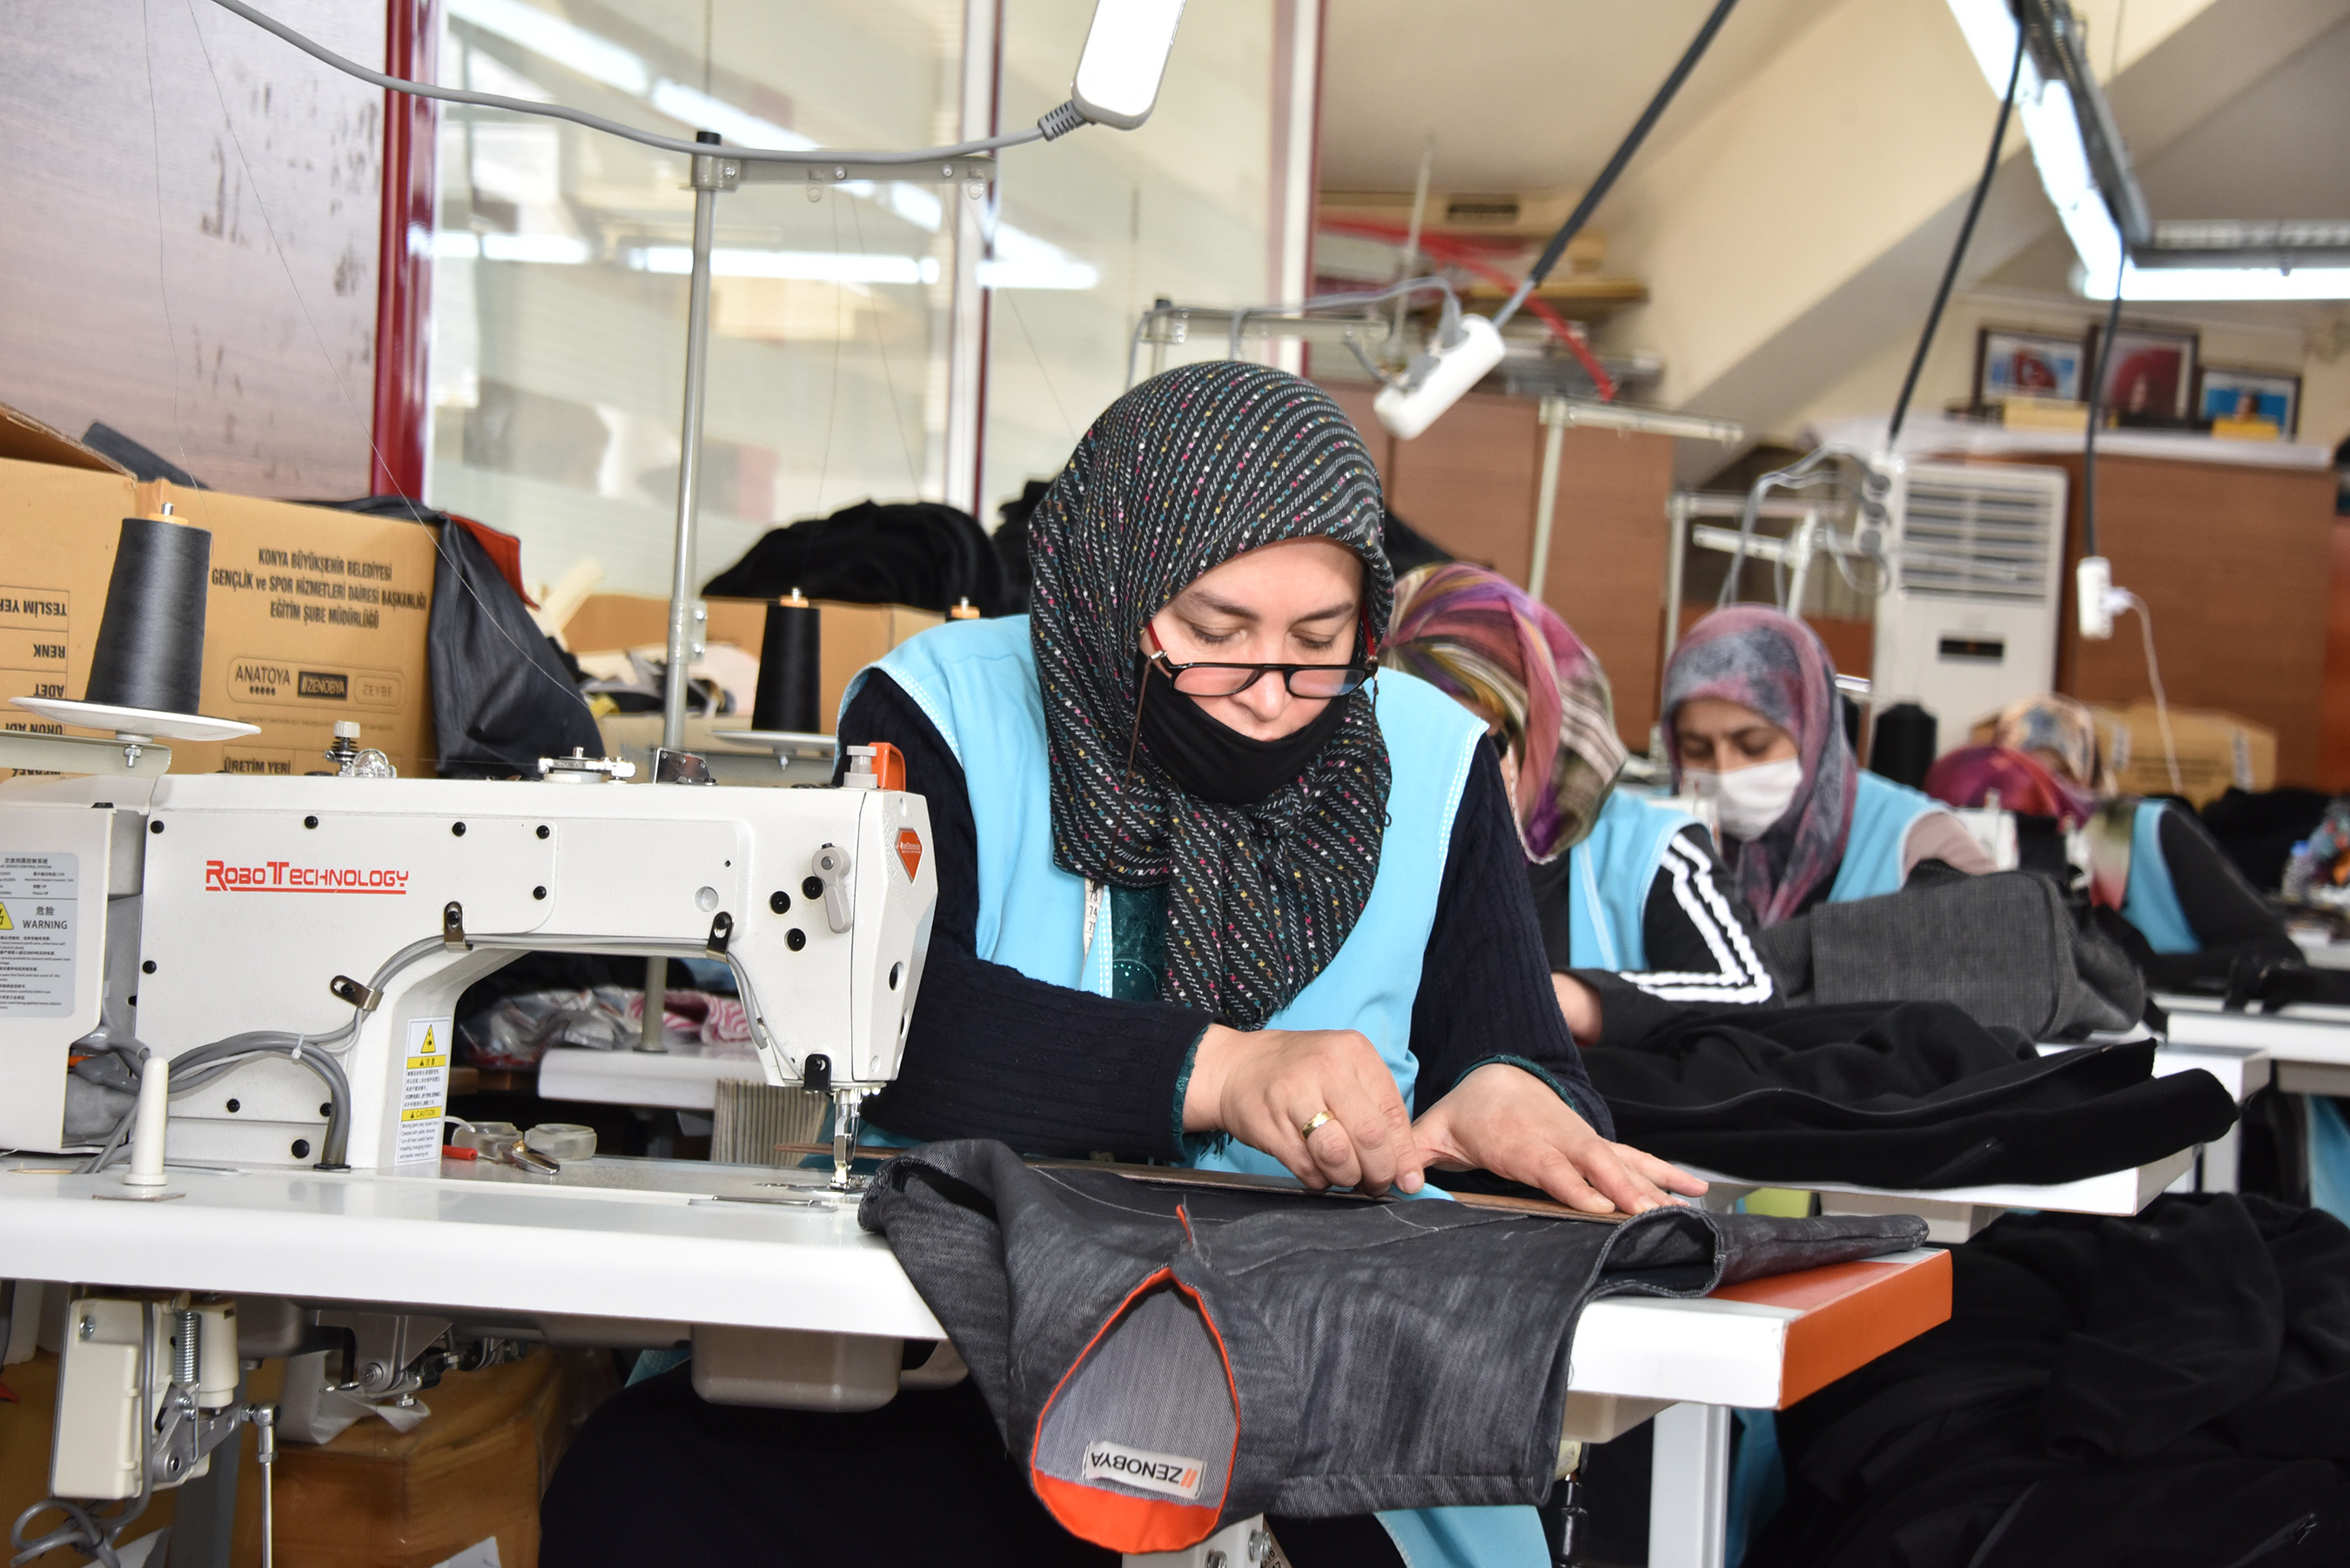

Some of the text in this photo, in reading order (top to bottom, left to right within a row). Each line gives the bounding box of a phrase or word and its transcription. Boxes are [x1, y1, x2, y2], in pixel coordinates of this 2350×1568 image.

[258, 548, 393, 581] KONYA BÜYÜKŞEHİR BELEDİYESİ
[212, 568, 426, 611] GENÇLİK ve SPOR HİZMETLERİ DAİRESİ BAŞKANLIĞI
[24, 600, 67, 618] TESLİM
[271, 599, 379, 629] EĞİTİM ŞUBE MÜDÜRLÜĞÜ
[33, 643, 66, 659] RENK
[235, 664, 291, 687] ANATOYA
[35, 684, 65, 698] ADET
[307, 676, 346, 695] ZENOBYA
[224, 757, 292, 774] ÜRETİM YERİ
[36, 906, 55, 916] 危险
[22, 920, 68, 930] WARNING
[415, 1109, 435, 1118] CAUTION
[1091, 1451, 1184, 1484] ZENOBYA
